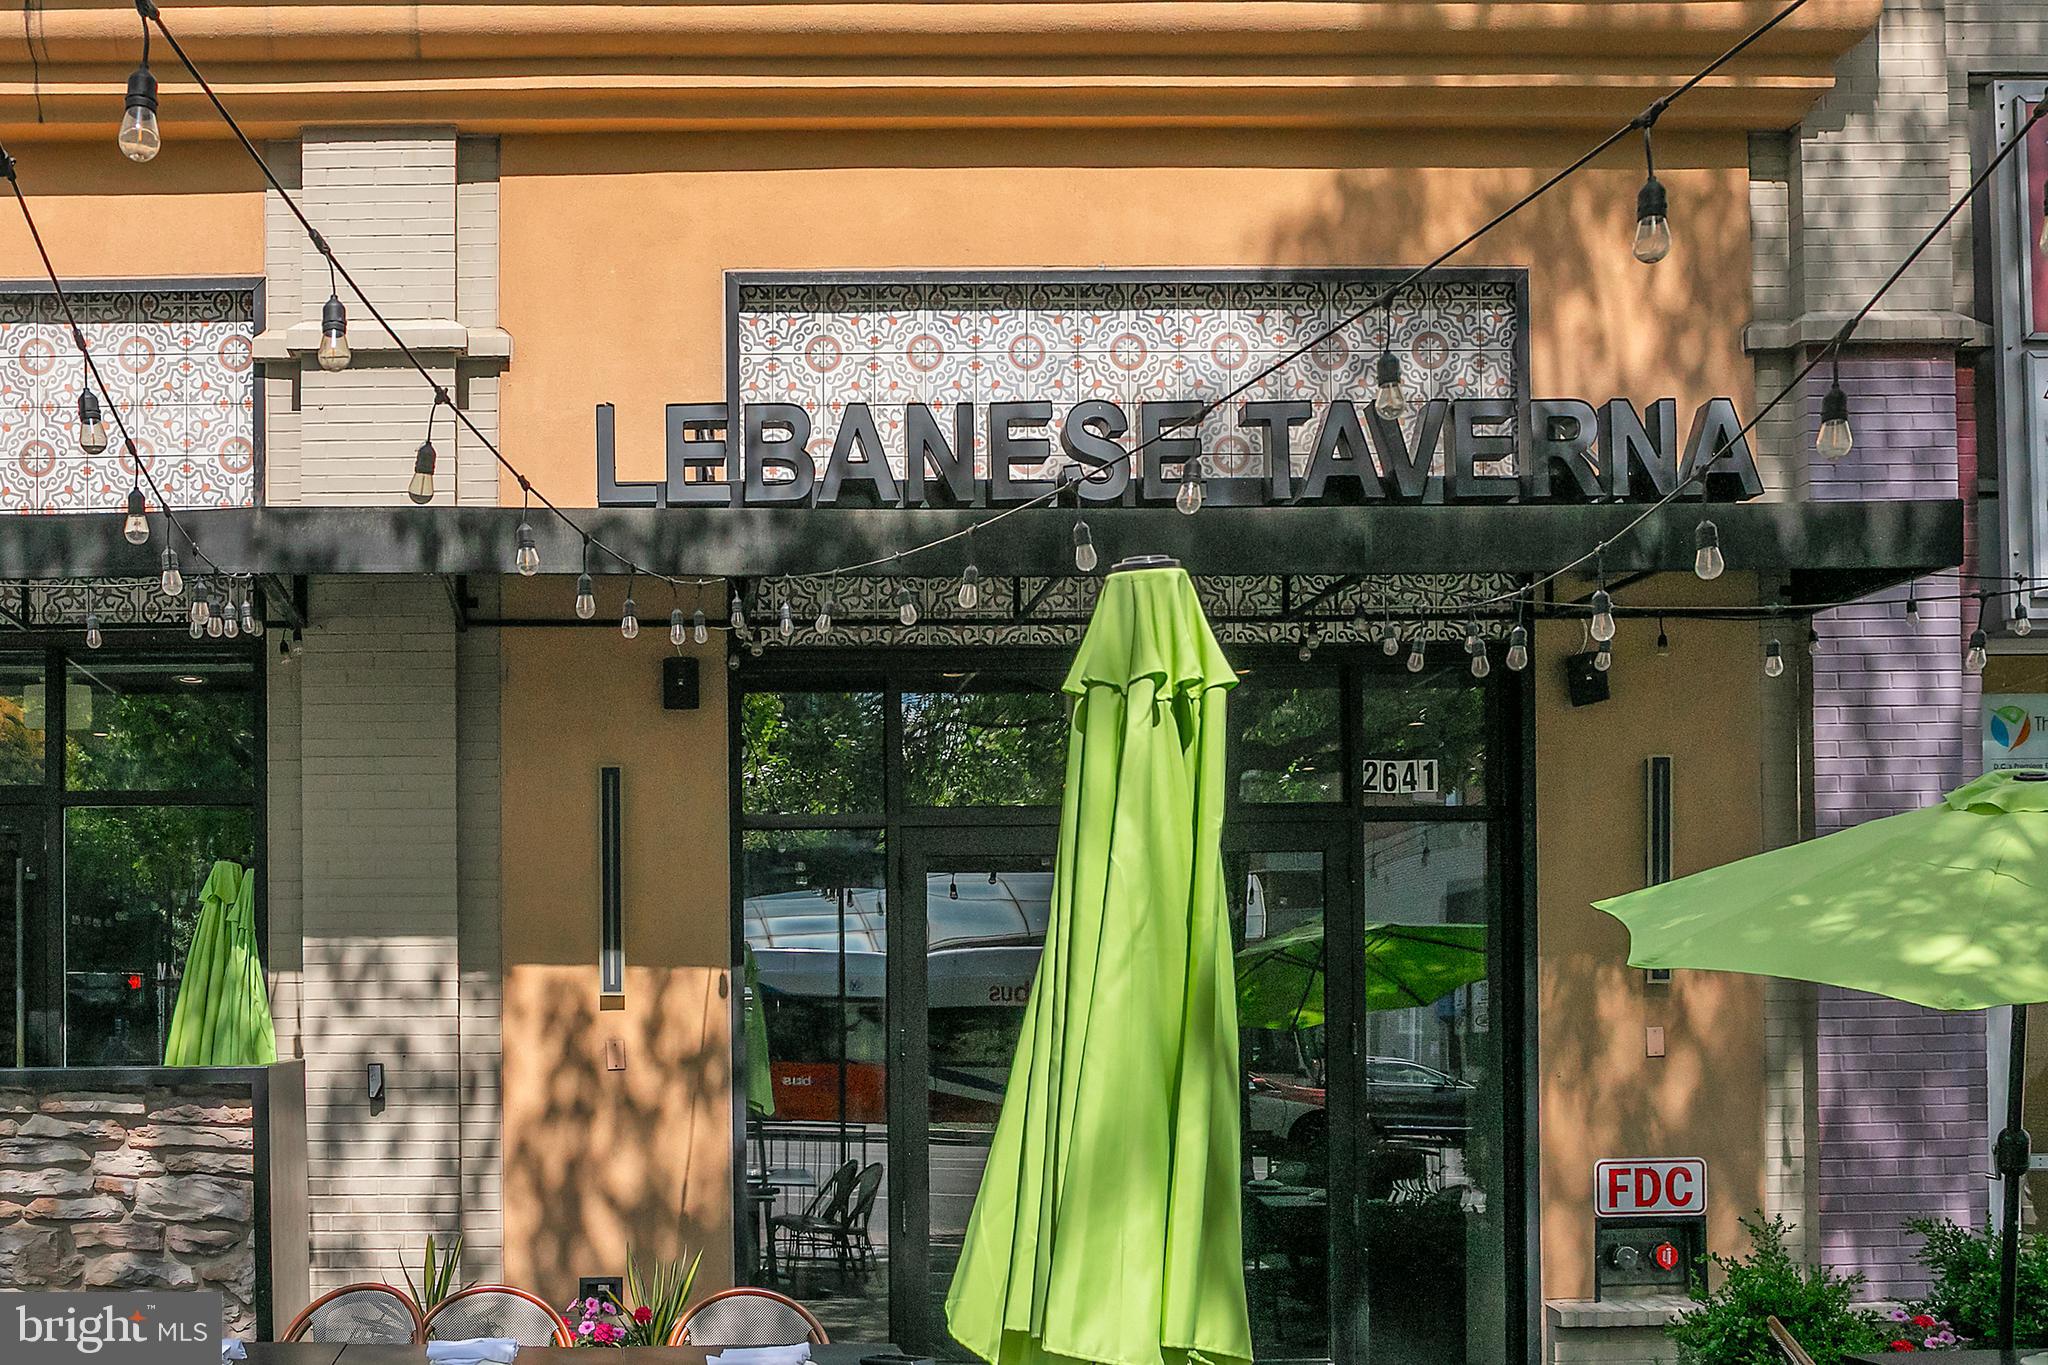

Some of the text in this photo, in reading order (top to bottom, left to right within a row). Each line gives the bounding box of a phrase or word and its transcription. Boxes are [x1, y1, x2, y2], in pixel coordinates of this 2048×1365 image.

[596, 398, 1765, 505] LEBANESE TAVERNA
[1363, 761, 1434, 792] 2641
[1608, 1167, 1693, 1208] FDC
